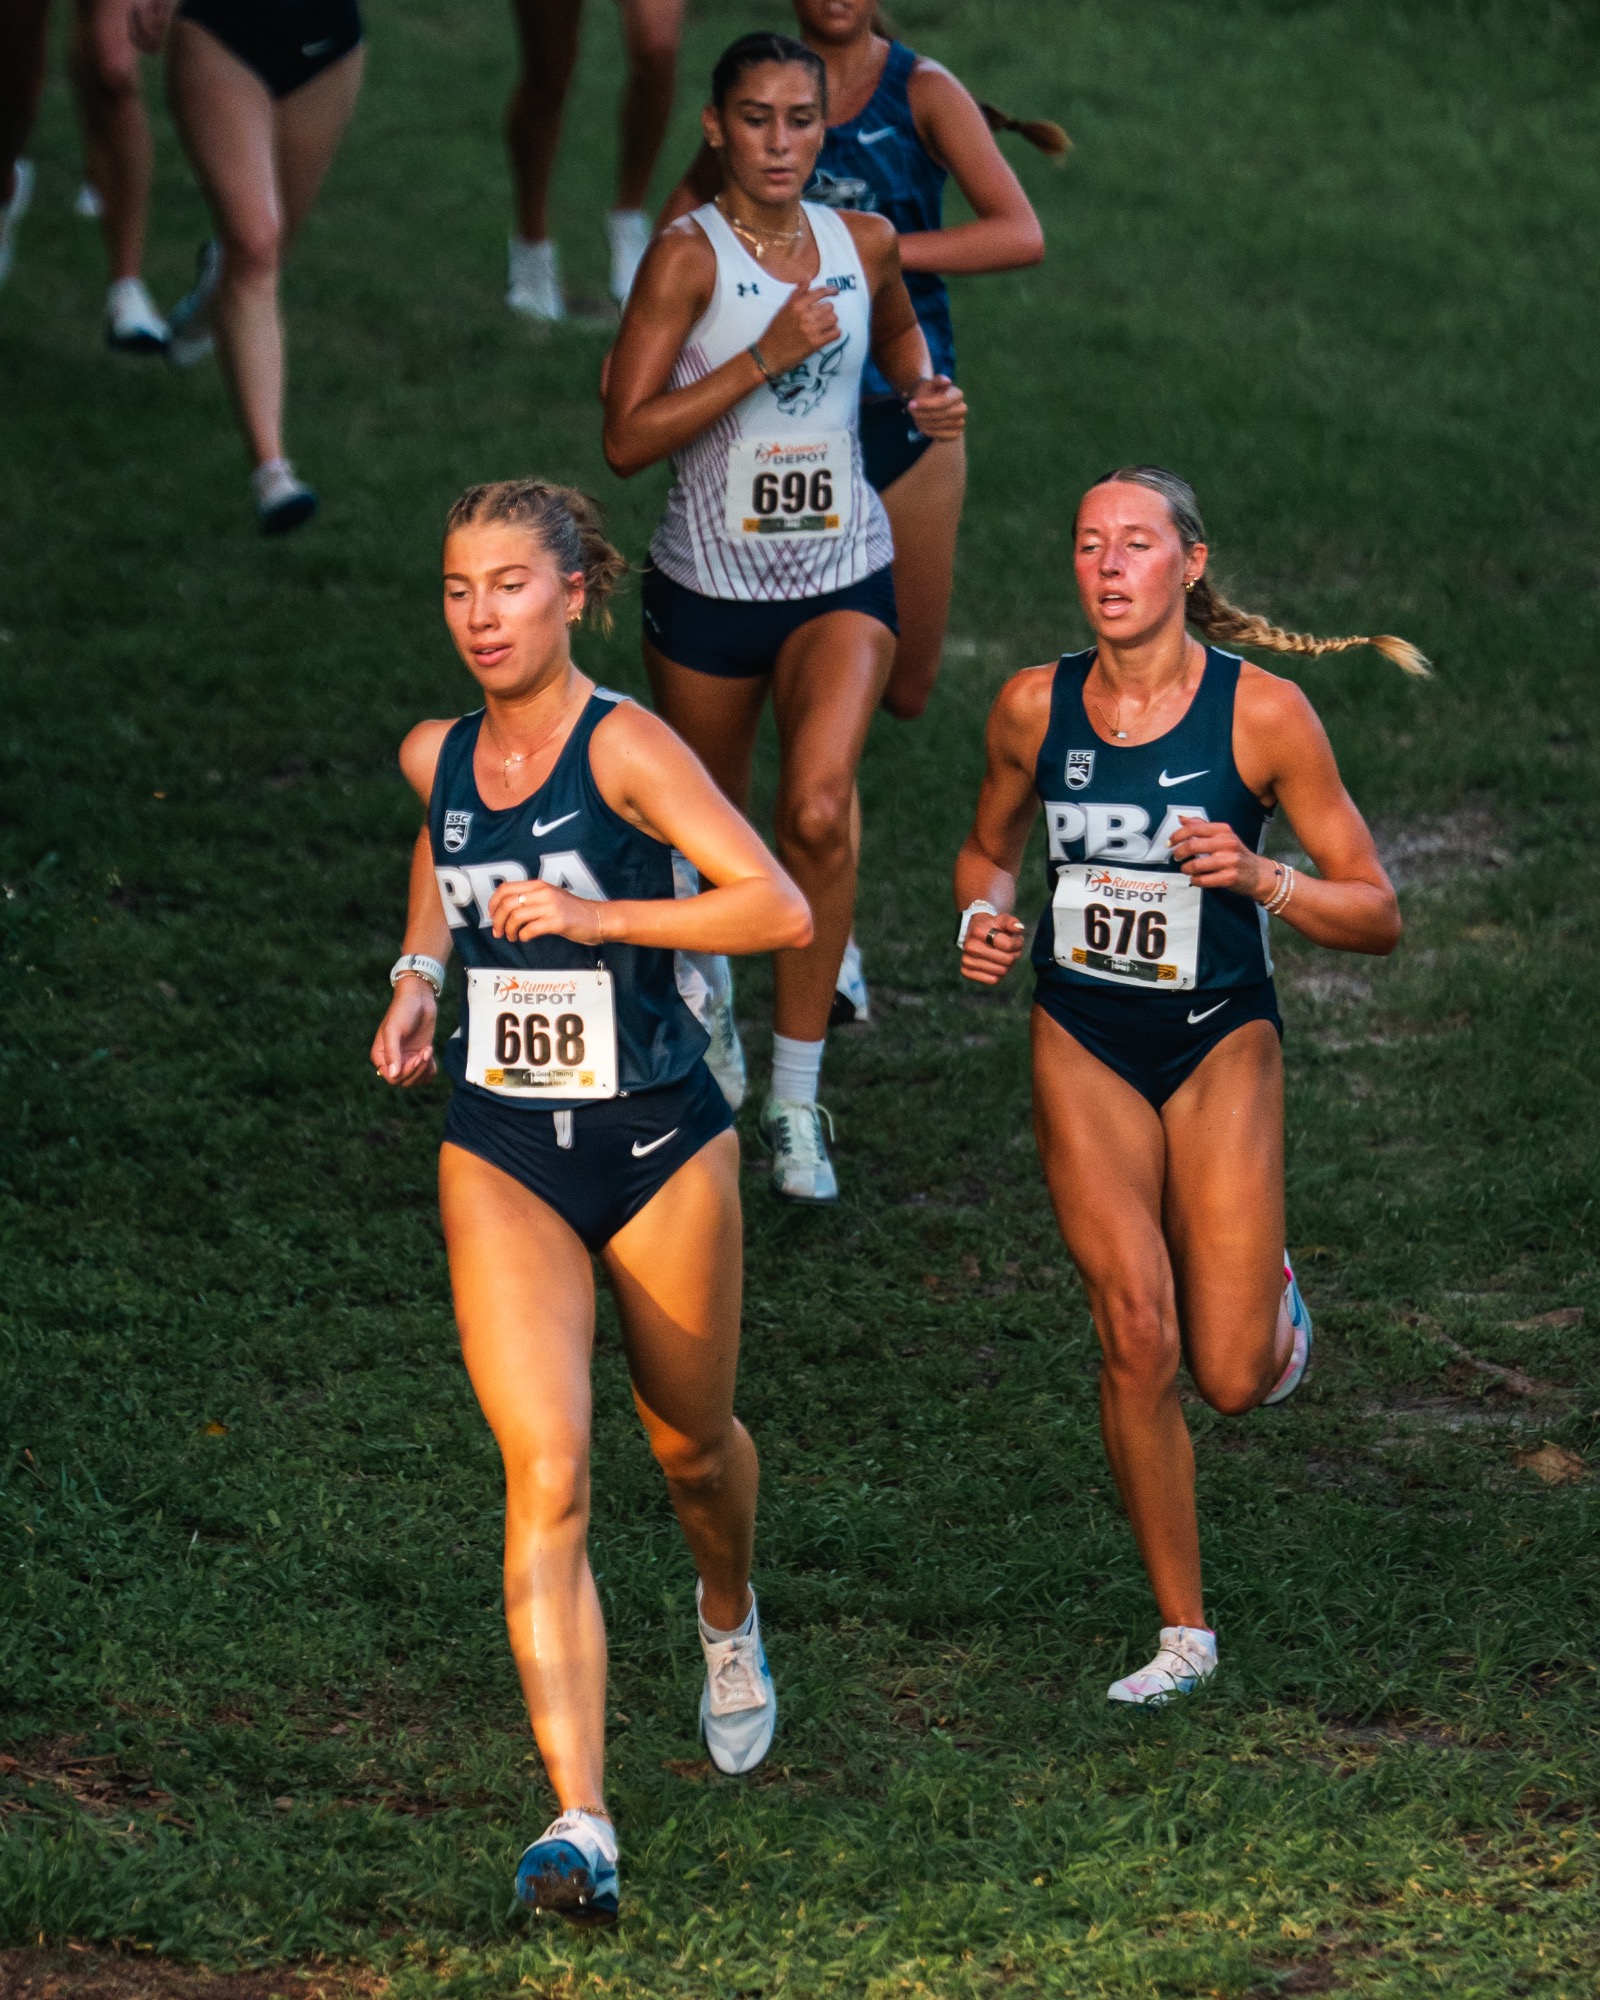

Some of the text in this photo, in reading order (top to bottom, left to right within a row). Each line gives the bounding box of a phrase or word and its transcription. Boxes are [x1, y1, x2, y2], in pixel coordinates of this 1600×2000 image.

[772, 452, 827, 464] DEPOT
[752, 469, 832, 514] 696
[1070, 753, 1091, 762] SSC
[448, 814, 469, 824] SSC
[1112, 876, 1169, 892] Runner's
[1103, 885, 1167, 903] DEPOT
[1083, 903, 1167, 960] 676
[520, 980, 577, 993] Runner's
[511, 992, 576, 1005] DEPOT
[494, 1012, 585, 1066] 668
[552, 1070, 573, 1079] Timing
